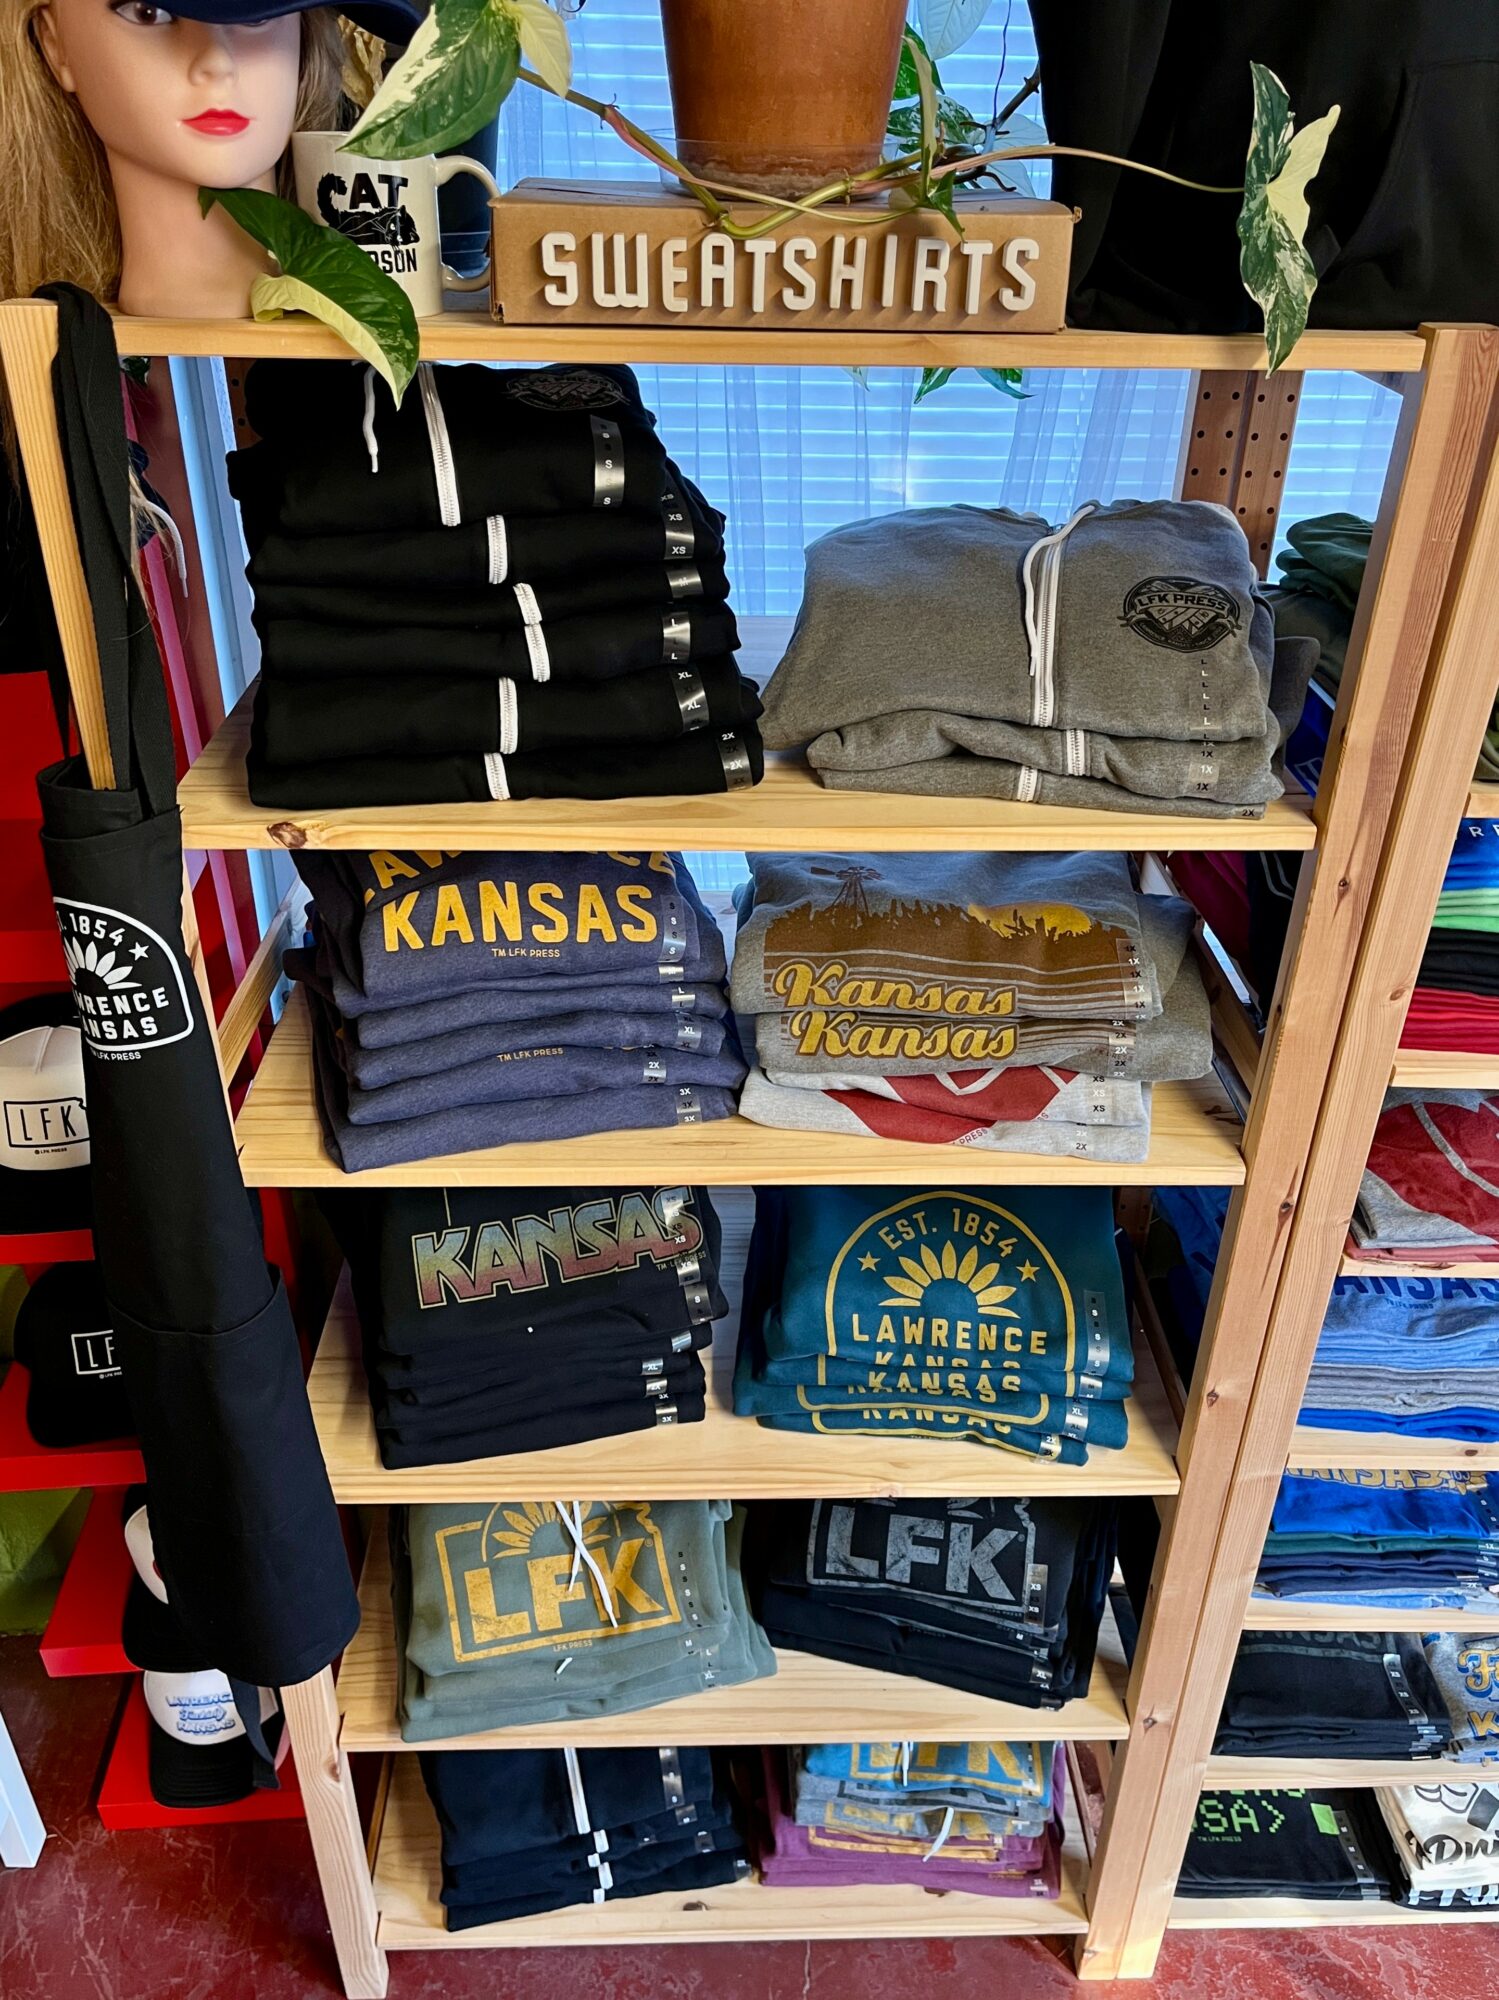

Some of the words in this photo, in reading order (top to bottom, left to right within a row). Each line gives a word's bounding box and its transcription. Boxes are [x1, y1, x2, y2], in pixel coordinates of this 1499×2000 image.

[317, 172, 409, 210] CAT
[541, 230, 1039, 315] SWEATSHIRTS
[1138, 594, 1170, 607] LFK
[1173, 594, 1229, 611] PRESS
[69, 913, 126, 947] 1854
[381, 880, 659, 952] KANSAS
[491, 948, 506, 957] TM
[508, 948, 527, 958] LFK
[529, 948, 561, 958] PRESS
[773, 960, 1018, 1018] Kansas
[82, 1016, 159, 1040] ANSAS
[790, 1010, 1020, 1061] Kansas
[111, 1051, 142, 1061] PRESS
[513, 1050, 532, 1061] LFK
[533, 1046, 564, 1058] PRESS
[20, 1105, 77, 1141] LFK
[411, 1187, 703, 1309] KANSAS
[878, 1208, 938, 1250] EST.
[953, 1208, 1019, 1258] 1854
[86, 1336, 115, 1368] LF
[852, 1313, 1048, 1354] LAWRENCE
[826, 1505, 1018, 1601] LFK
[464, 1537, 664, 1644] LFK
[553, 1642, 568, 1652] LFK
[569, 1639, 593, 1649] PRESS
